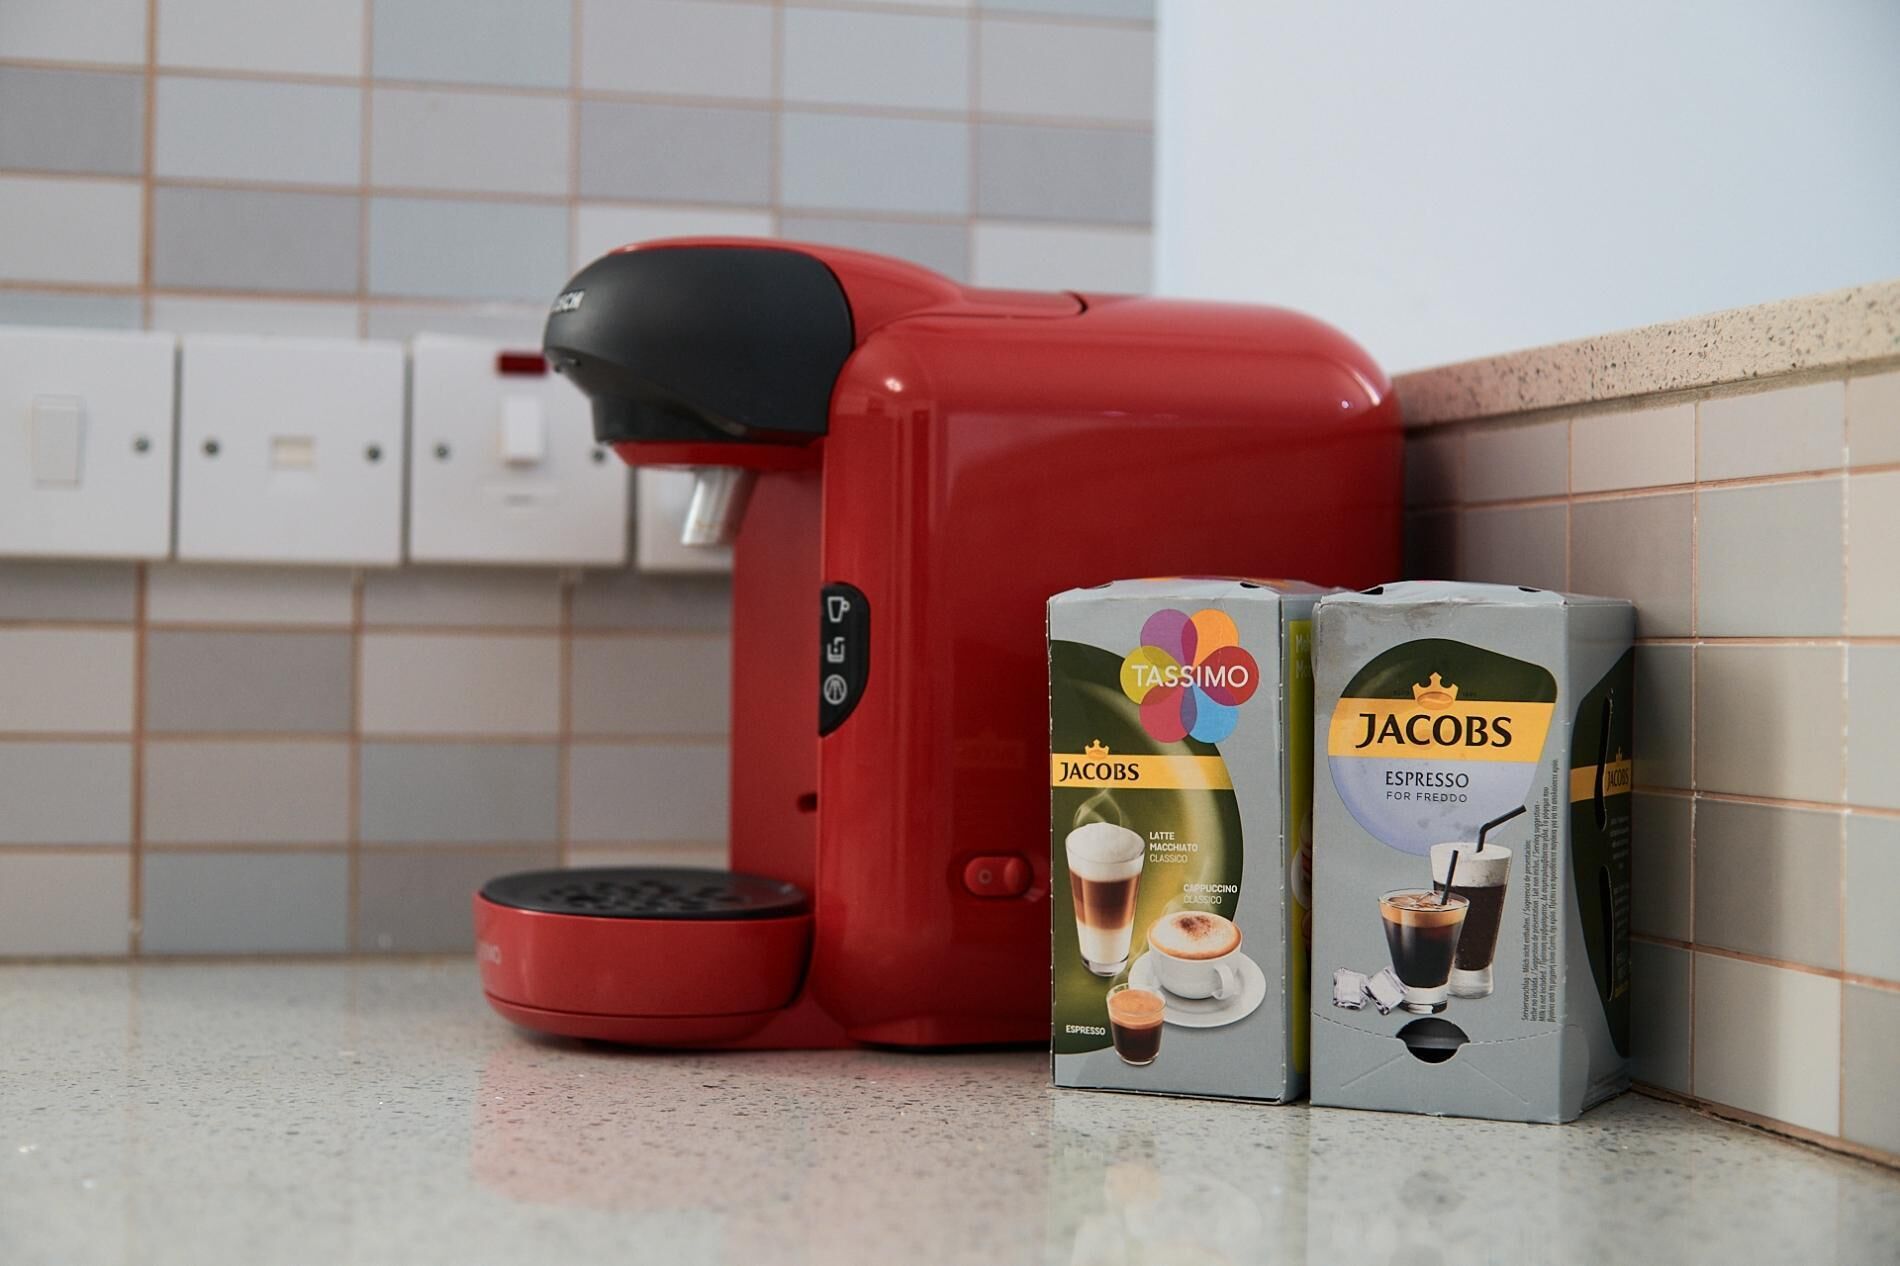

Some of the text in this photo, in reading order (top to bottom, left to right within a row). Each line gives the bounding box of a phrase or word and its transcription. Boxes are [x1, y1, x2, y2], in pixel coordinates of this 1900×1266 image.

[1131, 665, 1249, 688] TASSIMO
[1355, 713, 1513, 749] JACOBS
[1059, 762, 1140, 782] JACOBS
[1386, 771, 1469, 788] ESPRESSO
[1606, 767, 1629, 792] JACOBS
[1386, 791, 1468, 803] FOR FREDDO
[1149, 831, 1175, 841] LATTE
[1149, 842, 1198, 852] MACCHIATO
[1149, 853, 1188, 863] CLASSICO
[1183, 883, 1238, 894] CAPPUCCINO
[1183, 895, 1222, 905] CLASSICO
[1065, 1024, 1106, 1036] ESPRESSO
